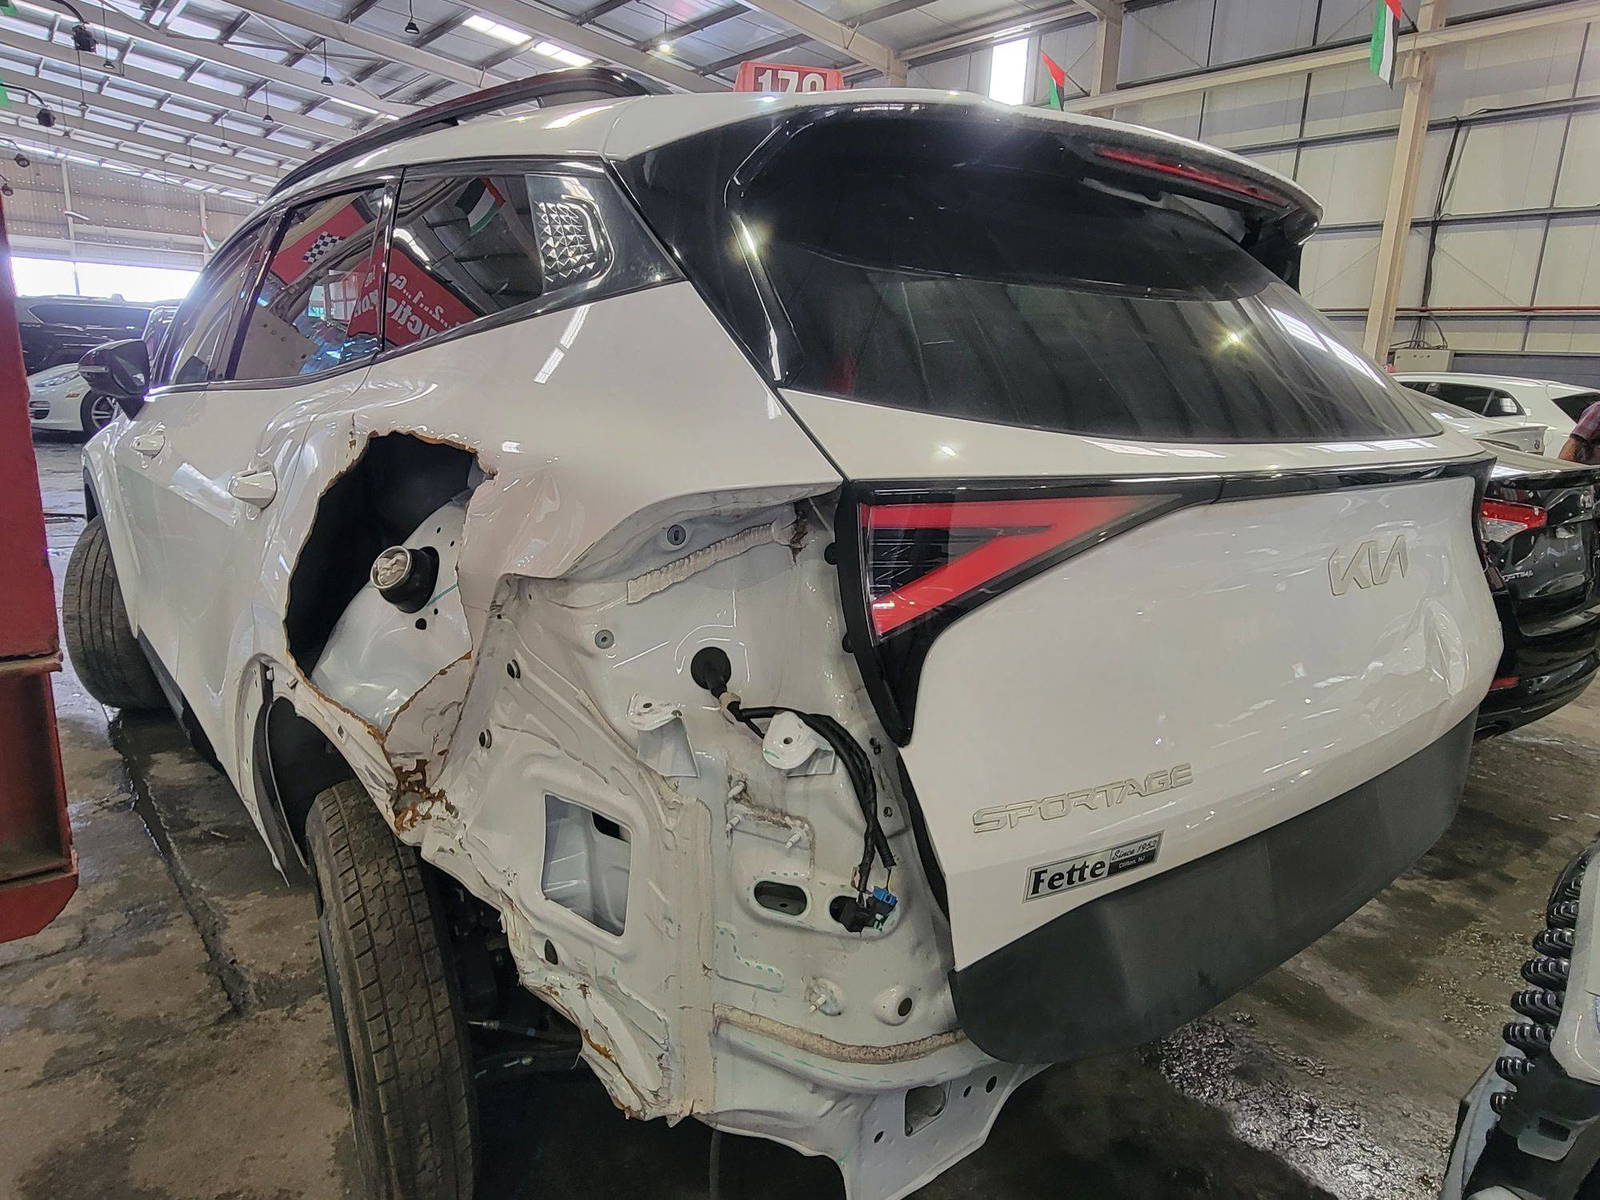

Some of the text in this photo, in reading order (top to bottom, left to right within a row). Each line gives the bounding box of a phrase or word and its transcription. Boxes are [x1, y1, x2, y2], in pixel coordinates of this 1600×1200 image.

[758, 70, 825, 93] 170
[972, 763, 1194, 834] SPORTAGE
[1111, 848, 1136, 861] Since
[1031, 860, 1106, 895] Fette
